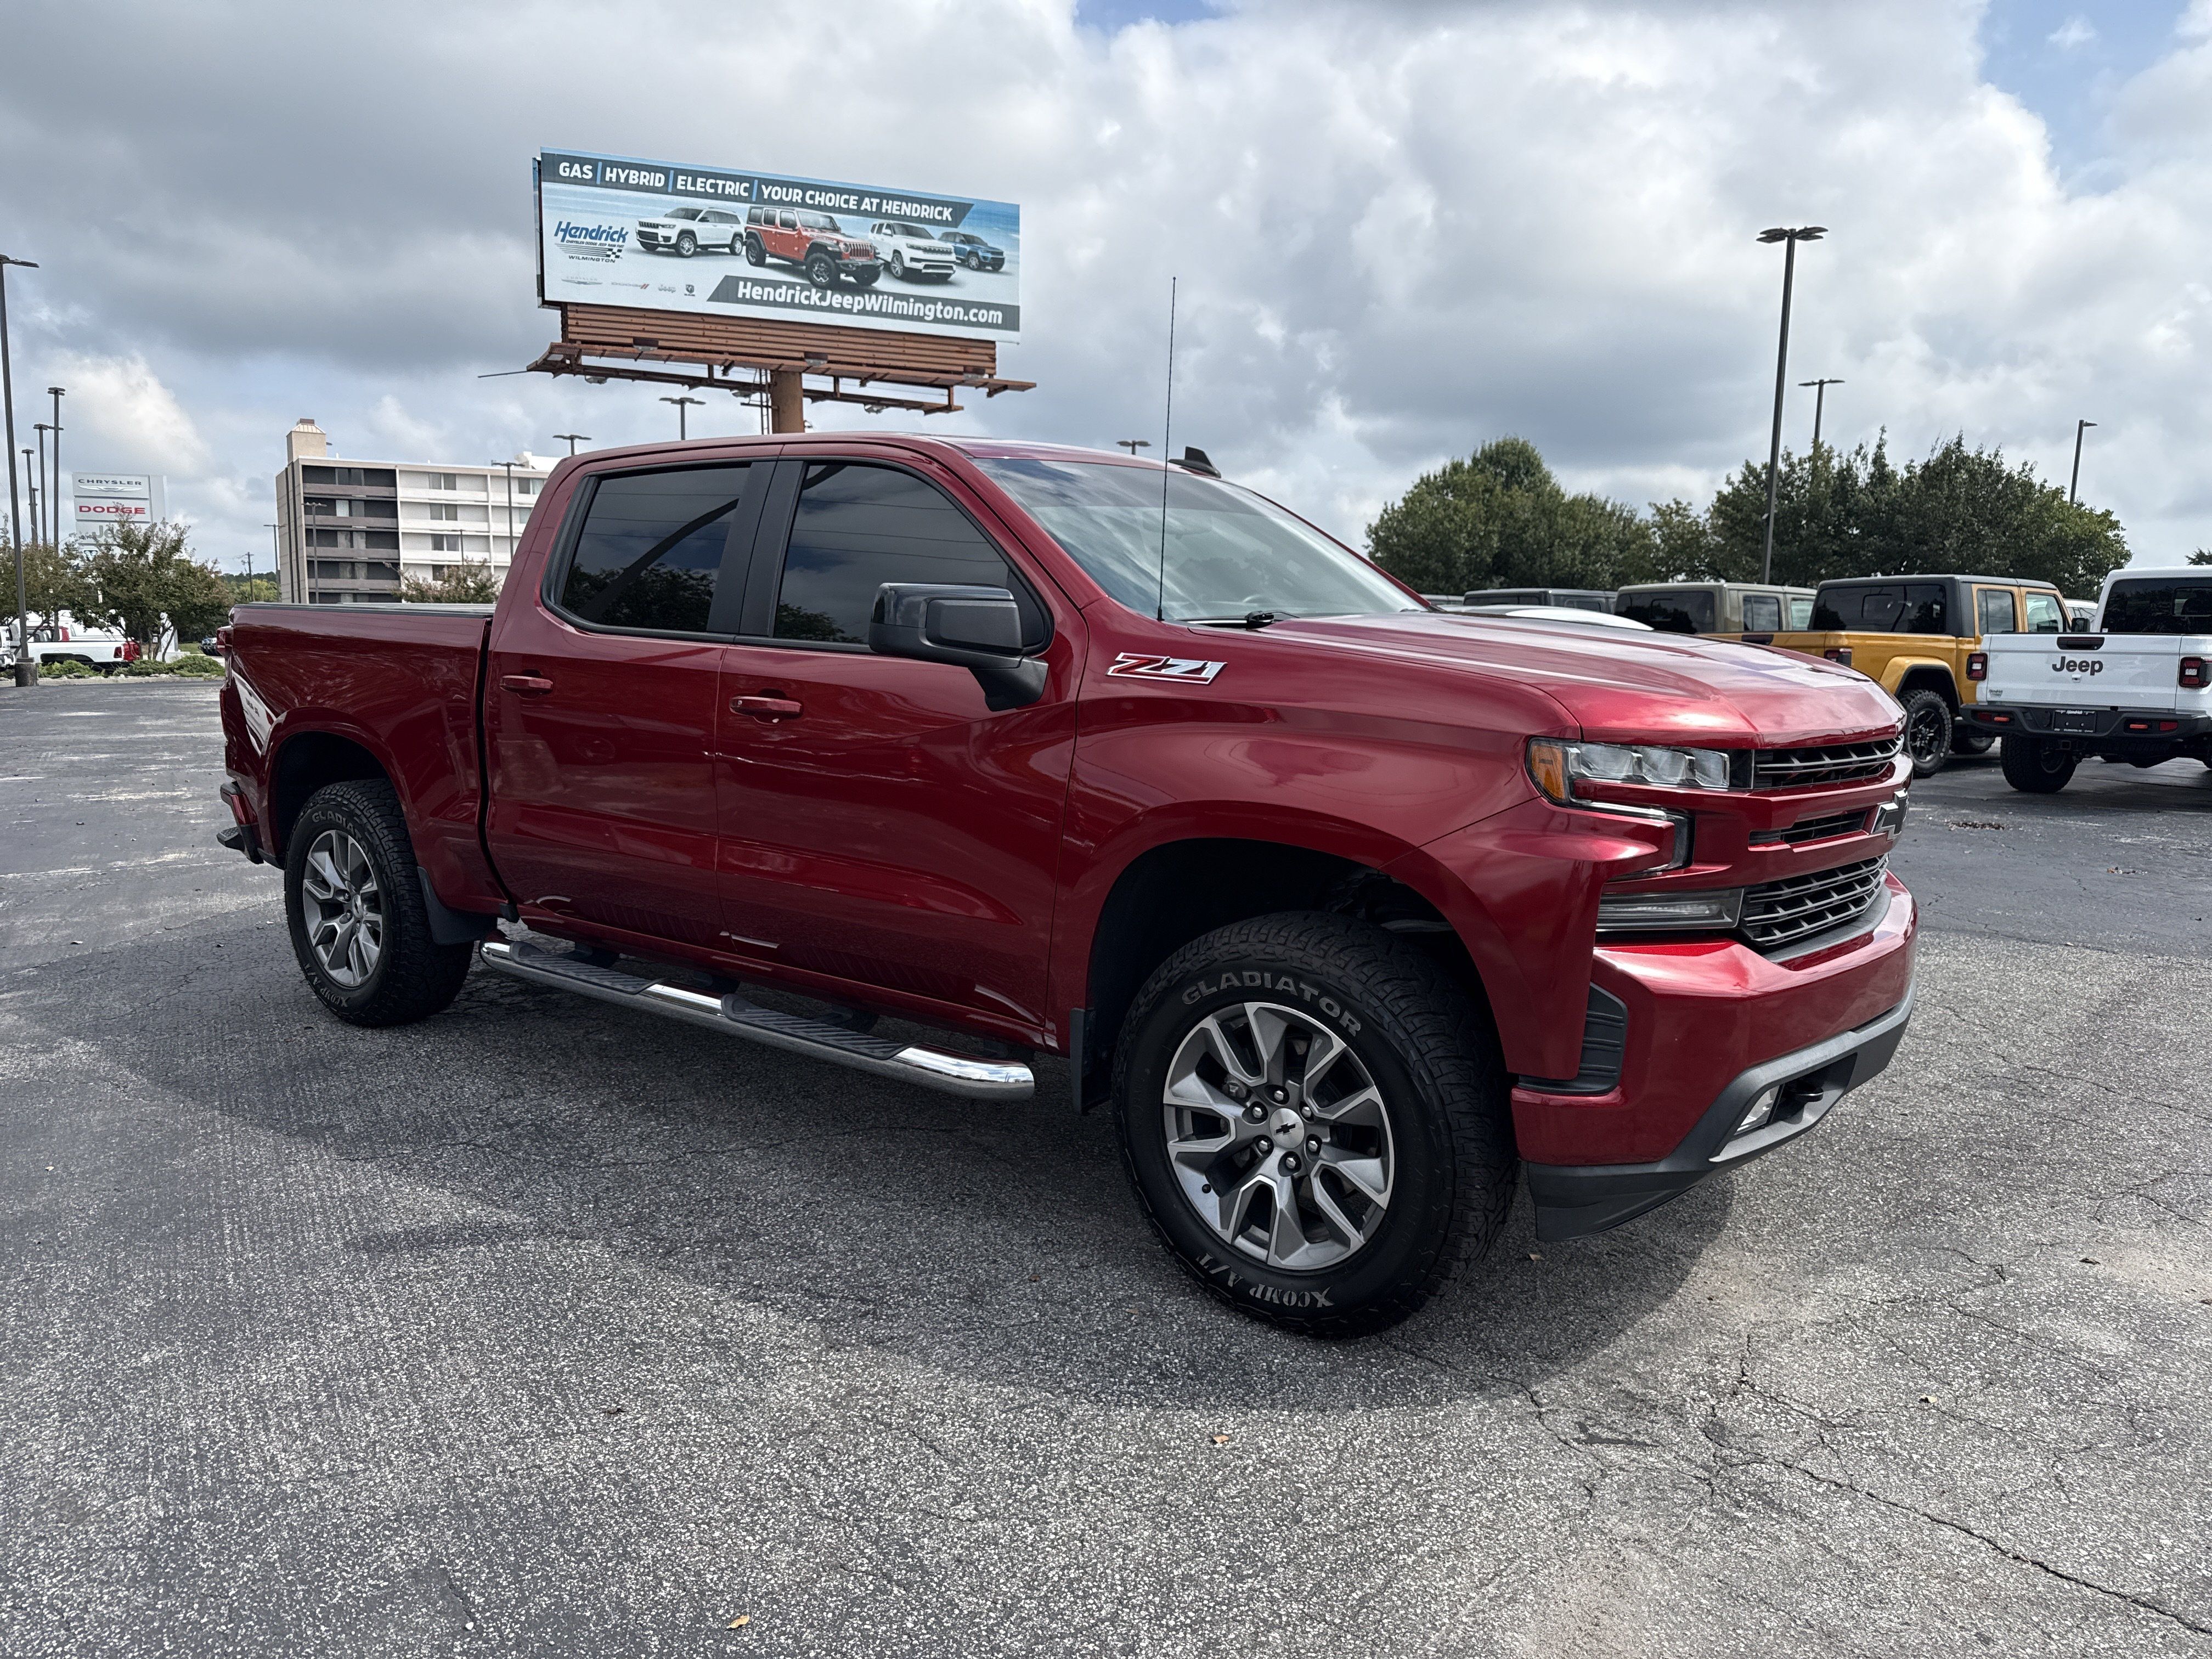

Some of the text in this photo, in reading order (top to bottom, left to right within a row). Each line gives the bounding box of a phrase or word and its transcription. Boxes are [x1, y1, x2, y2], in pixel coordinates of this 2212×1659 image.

[558, 162, 952, 221] GAS HYBRID ELECTRIC YOUR CHOICE AT HENDRICK
[554, 221, 629, 243] Hendrick
[737, 280, 1003, 324] HendrickJeepWilmington.com
[78, 505, 146, 515] DODGE
[1105, 652, 1228, 685] Z71
[2052, 656, 2103, 676] Jeep
[312, 810, 374, 866] GLADIATOR
[1182, 970, 1361, 1037] GLADIATOR
[1195, 1252, 1335, 1308] XCOMP A/T
